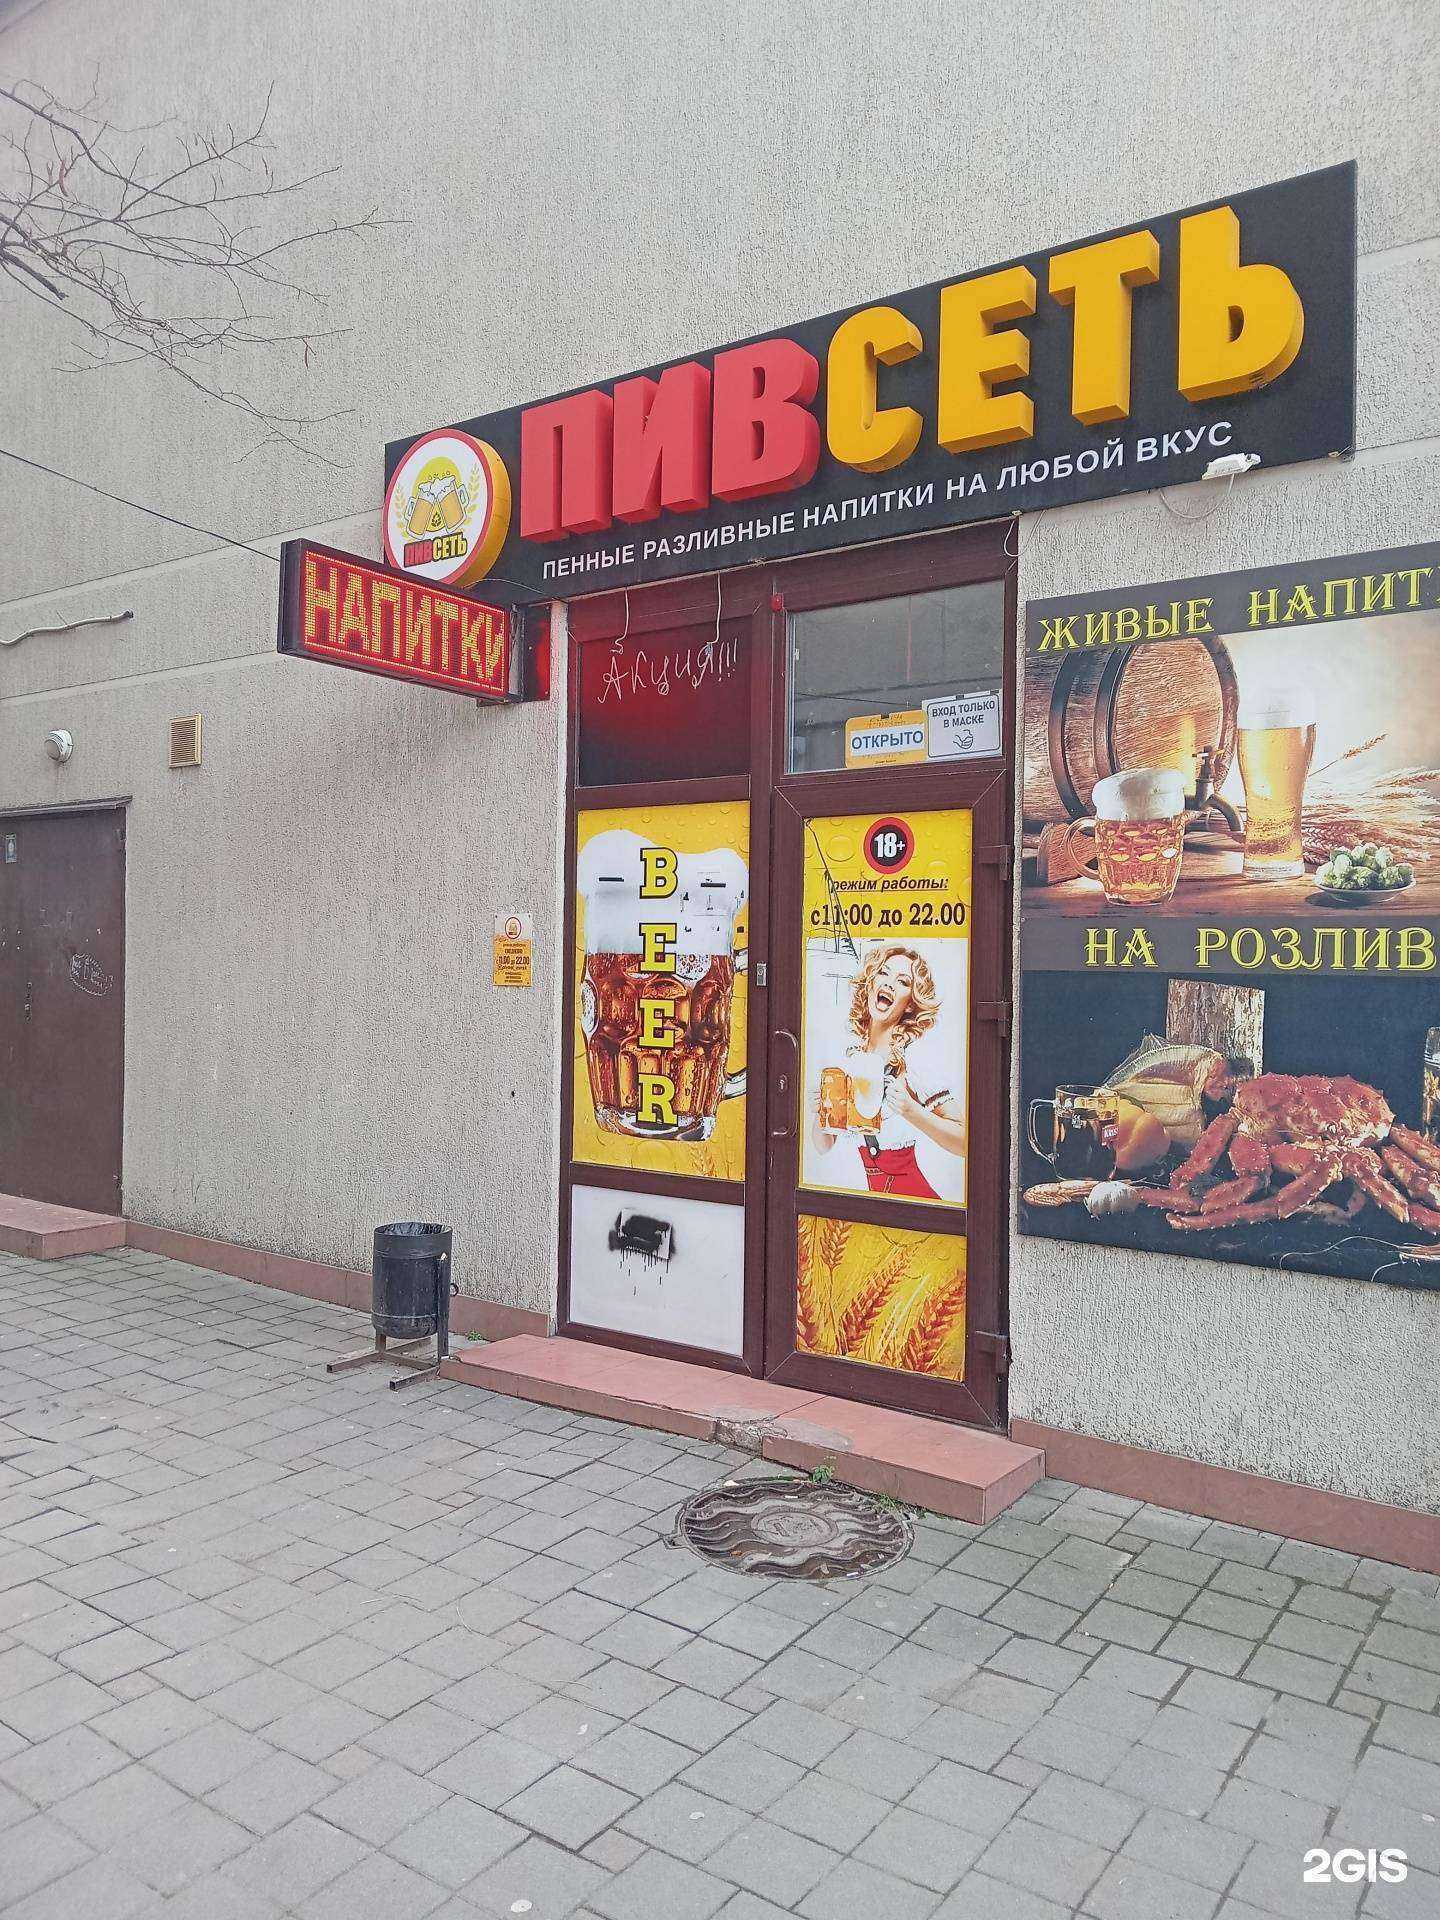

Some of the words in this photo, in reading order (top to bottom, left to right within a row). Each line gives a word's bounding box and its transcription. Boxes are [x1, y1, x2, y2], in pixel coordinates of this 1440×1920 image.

[519, 205, 1305, 544] ПИВСЕТЬ
[542, 543, 635, 579] ПЕННЫЕ
[642, 511, 795, 560] РАЗЛИВНЫЕ
[802, 482, 934, 529] НАПИТКИ
[946, 472, 988, 500] НА
[996, 437, 1124, 491] ЛЮБОЙ
[1135, 420, 1233, 463] ВКУС
[404, 532, 468, 567] ПИВСЕТЬ
[304, 560, 504, 681] НАПИТКИ
[1037, 596, 1216, 652] ЖИВЫЕ
[1247, 565, 1440, 627] НАПИТ
[932, 704, 957, 718] ВХОД
[958, 700, 996, 714] ТОЛЬКО
[943, 718, 950, 729] В
[952, 714, 985, 728] МАСКЕ
[851, 730, 924, 750] ОТКРЫТО
[874, 832, 906, 859] 18+
[832, 879, 877, 892] режим
[881, 875, 949, 892] работы:
[878, 909, 903, 927] до
[909, 902, 966, 926] 22.00
[1083, 927, 1159, 969] НА
[1193, 926, 1438, 972] РОЗЛИВ
